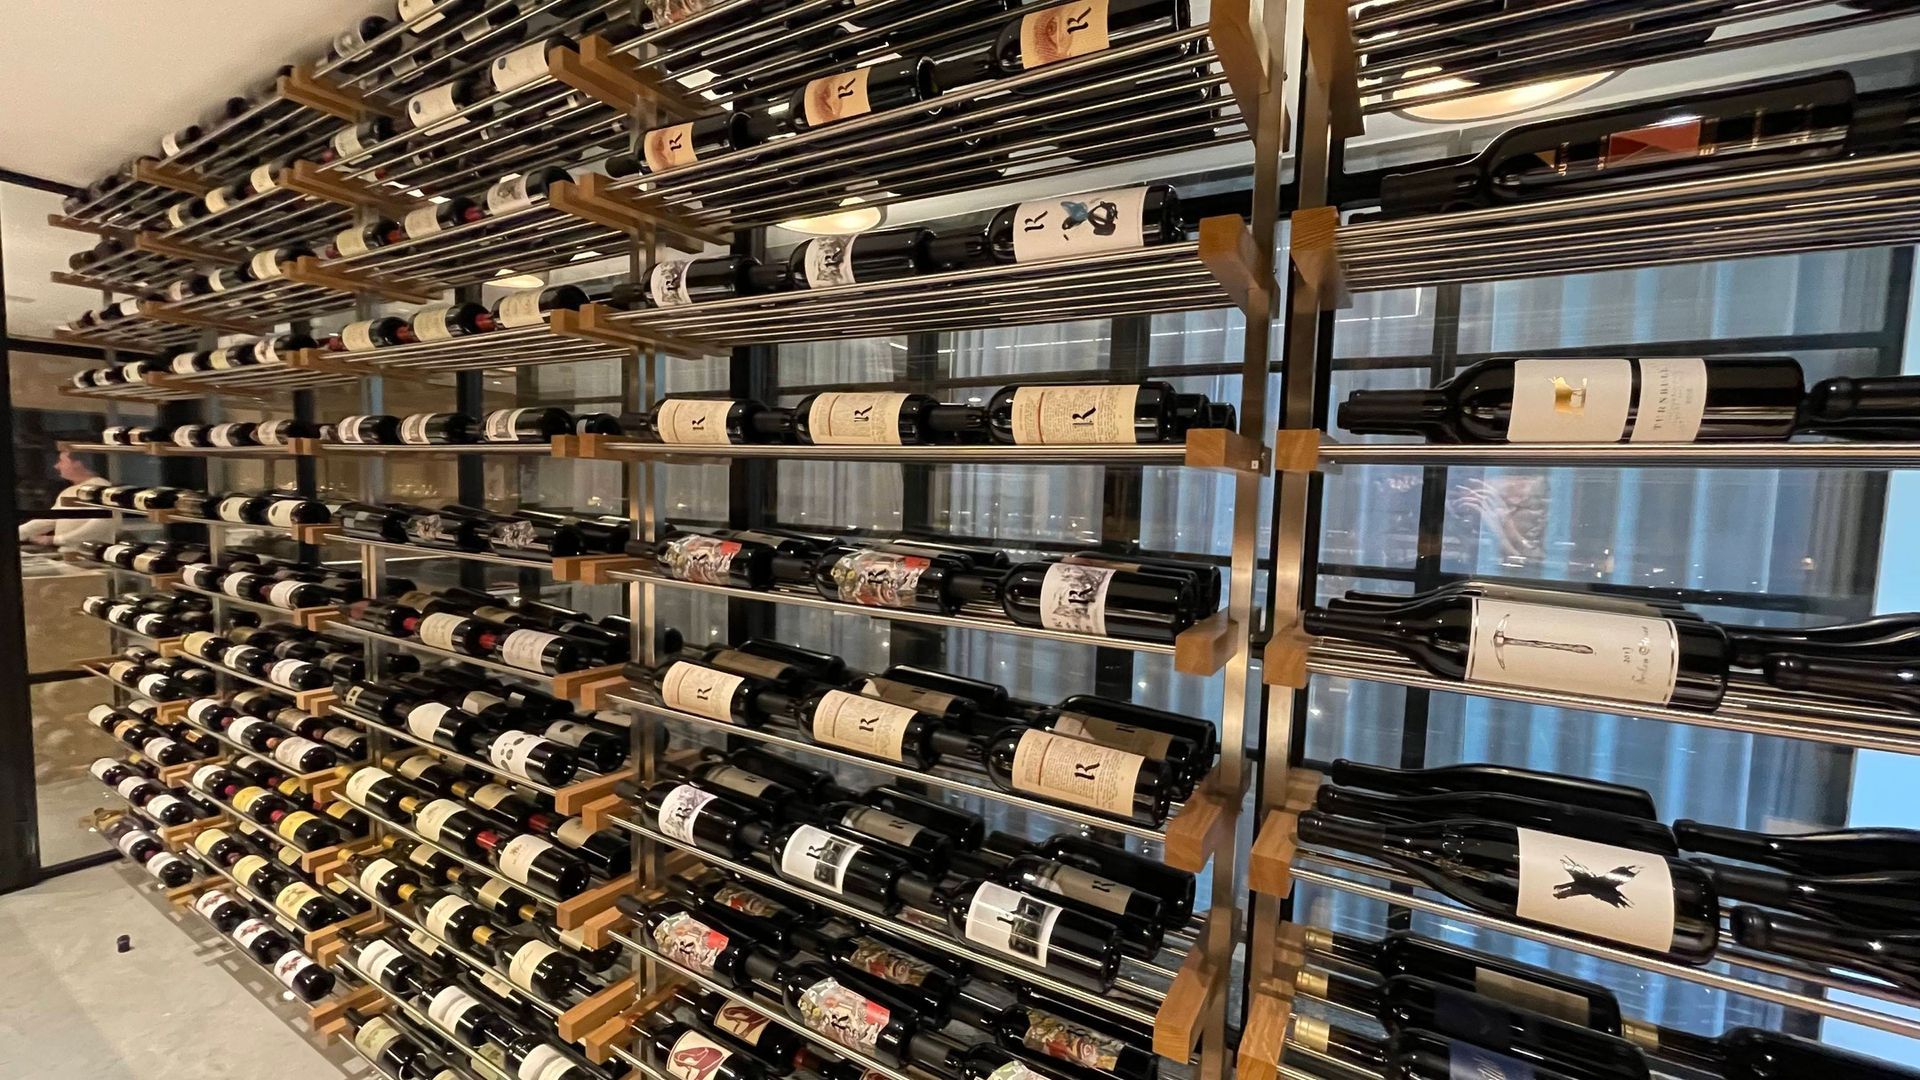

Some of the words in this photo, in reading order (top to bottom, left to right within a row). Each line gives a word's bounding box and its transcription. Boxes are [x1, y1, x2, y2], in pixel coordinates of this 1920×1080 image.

[1068, 6, 1093, 34] R
[838, 78, 857, 99] R
[668, 132, 683, 152] R
[1024, 211, 1049, 233] R
[692, 416, 706, 431] R
[854, 405, 873, 423] R
[1072, 407, 1097, 427] R
[1068, 587, 1096, 606] R
[697, 687, 713, 701] R
[859, 716, 880, 733] R
[1074, 763, 1101, 782] R
